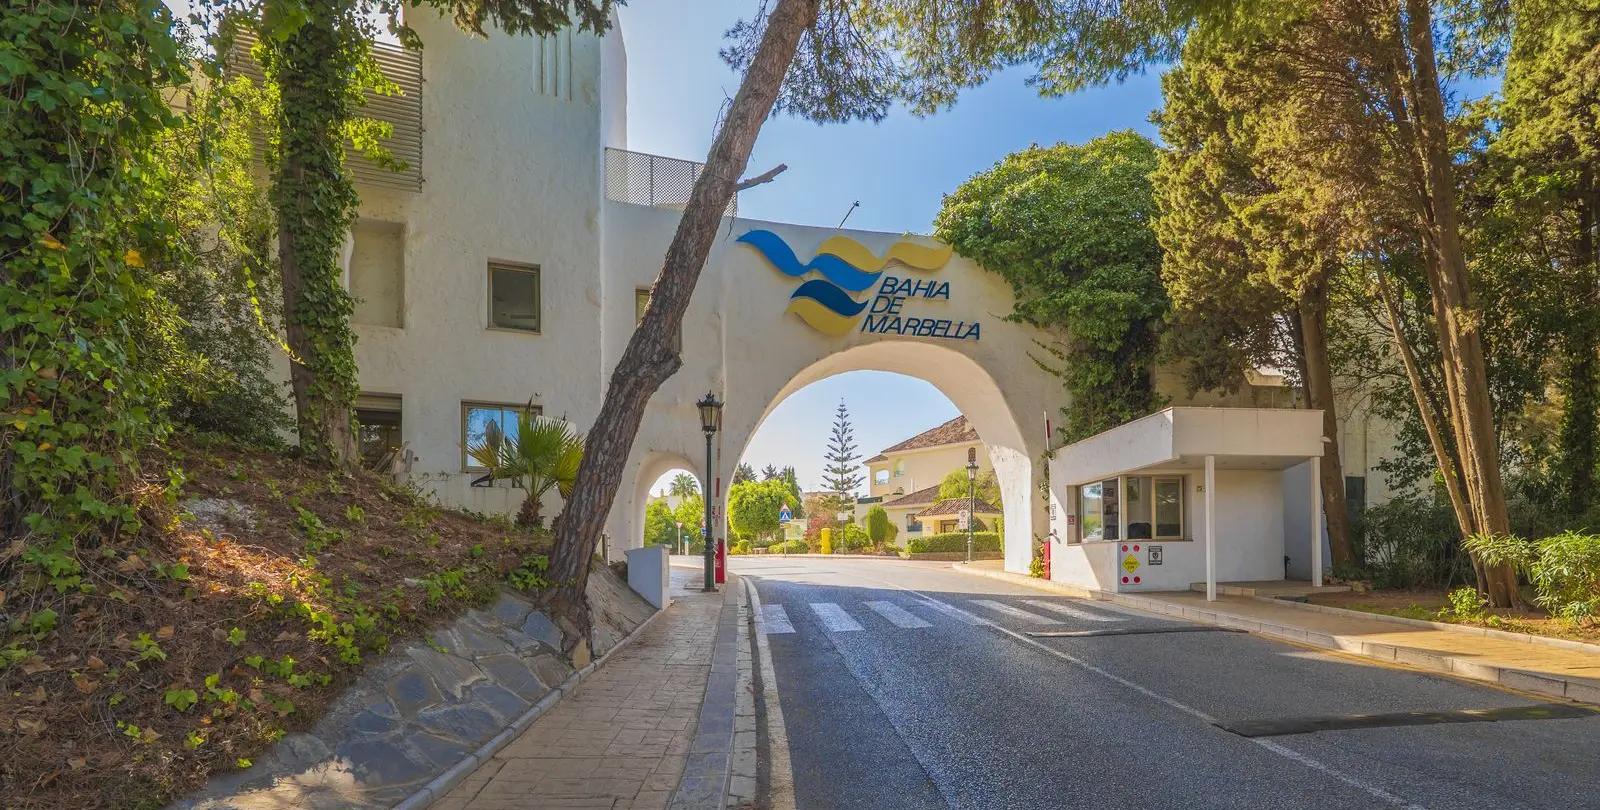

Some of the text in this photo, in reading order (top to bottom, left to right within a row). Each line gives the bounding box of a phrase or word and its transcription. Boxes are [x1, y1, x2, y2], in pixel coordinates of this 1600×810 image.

[878, 276, 950, 299] BAHIA
[870, 295, 906, 314] DE
[861, 314, 980, 340] MARBELLA
